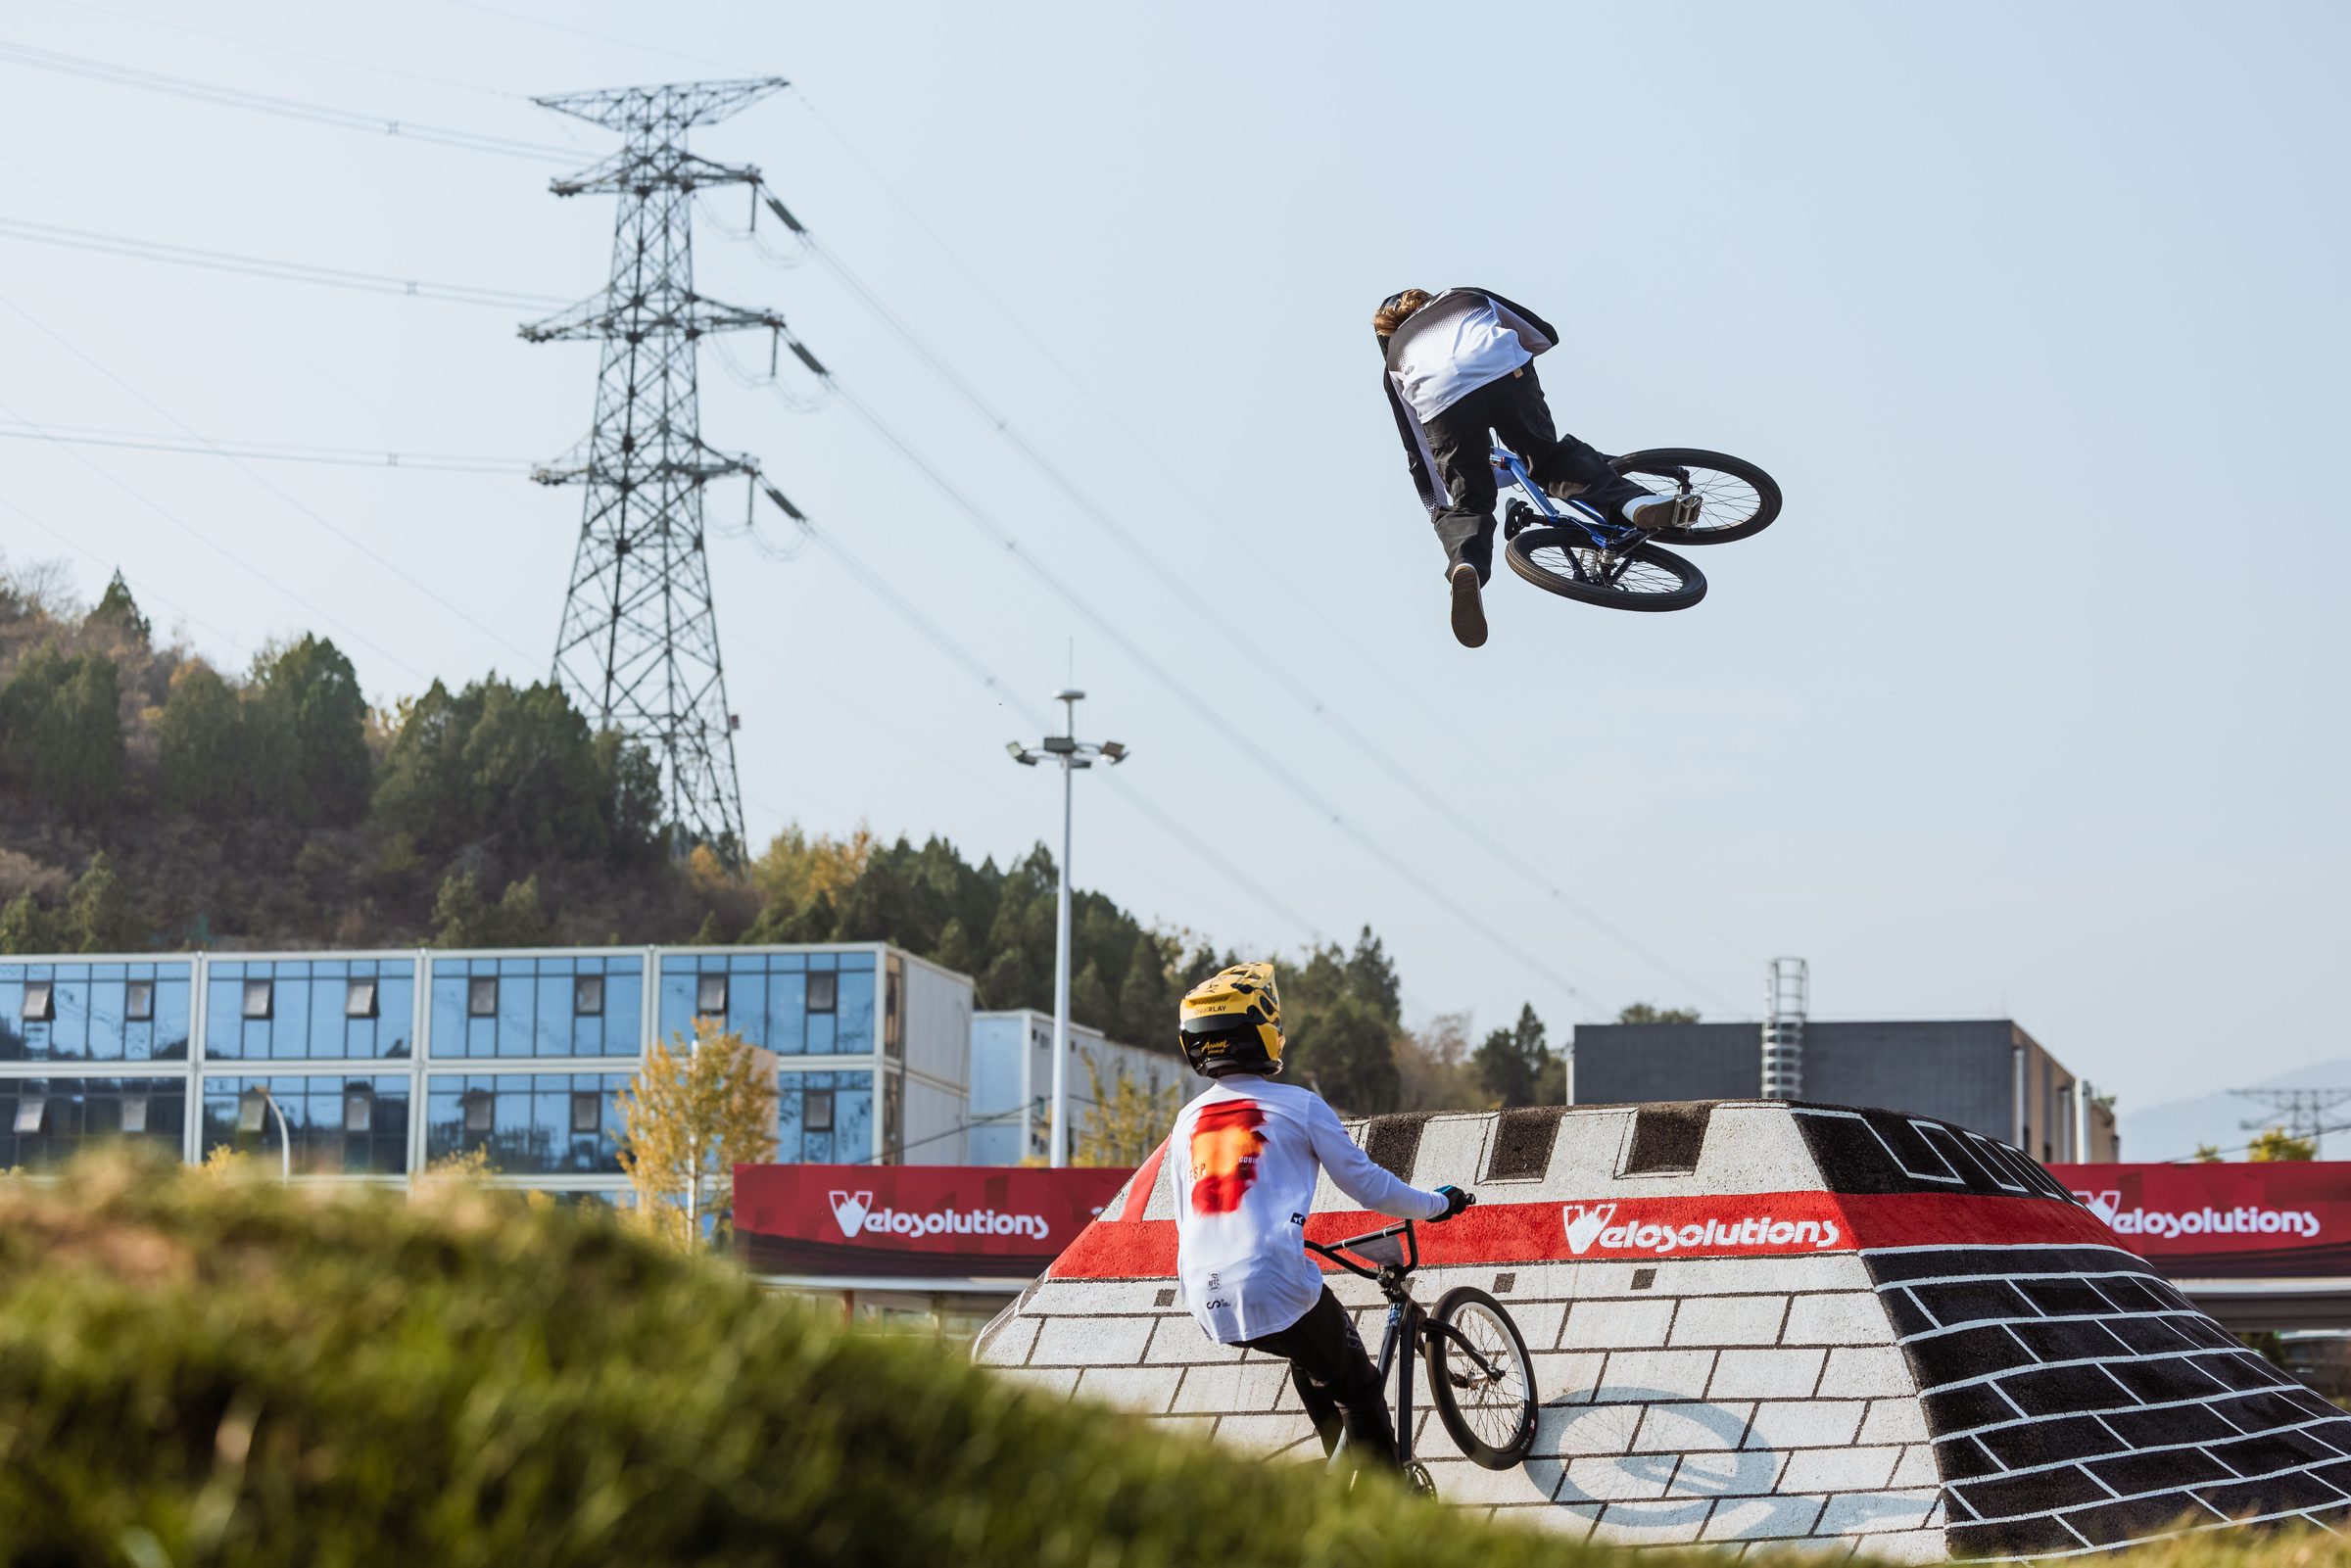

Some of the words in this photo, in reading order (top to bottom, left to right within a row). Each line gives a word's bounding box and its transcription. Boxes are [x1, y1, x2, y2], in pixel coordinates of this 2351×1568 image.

[829, 1190, 1049, 1239] Velosolutions
[1563, 1204, 1841, 1255] Velosolutions
[2073, 1190, 2321, 1238] Velosolutions
